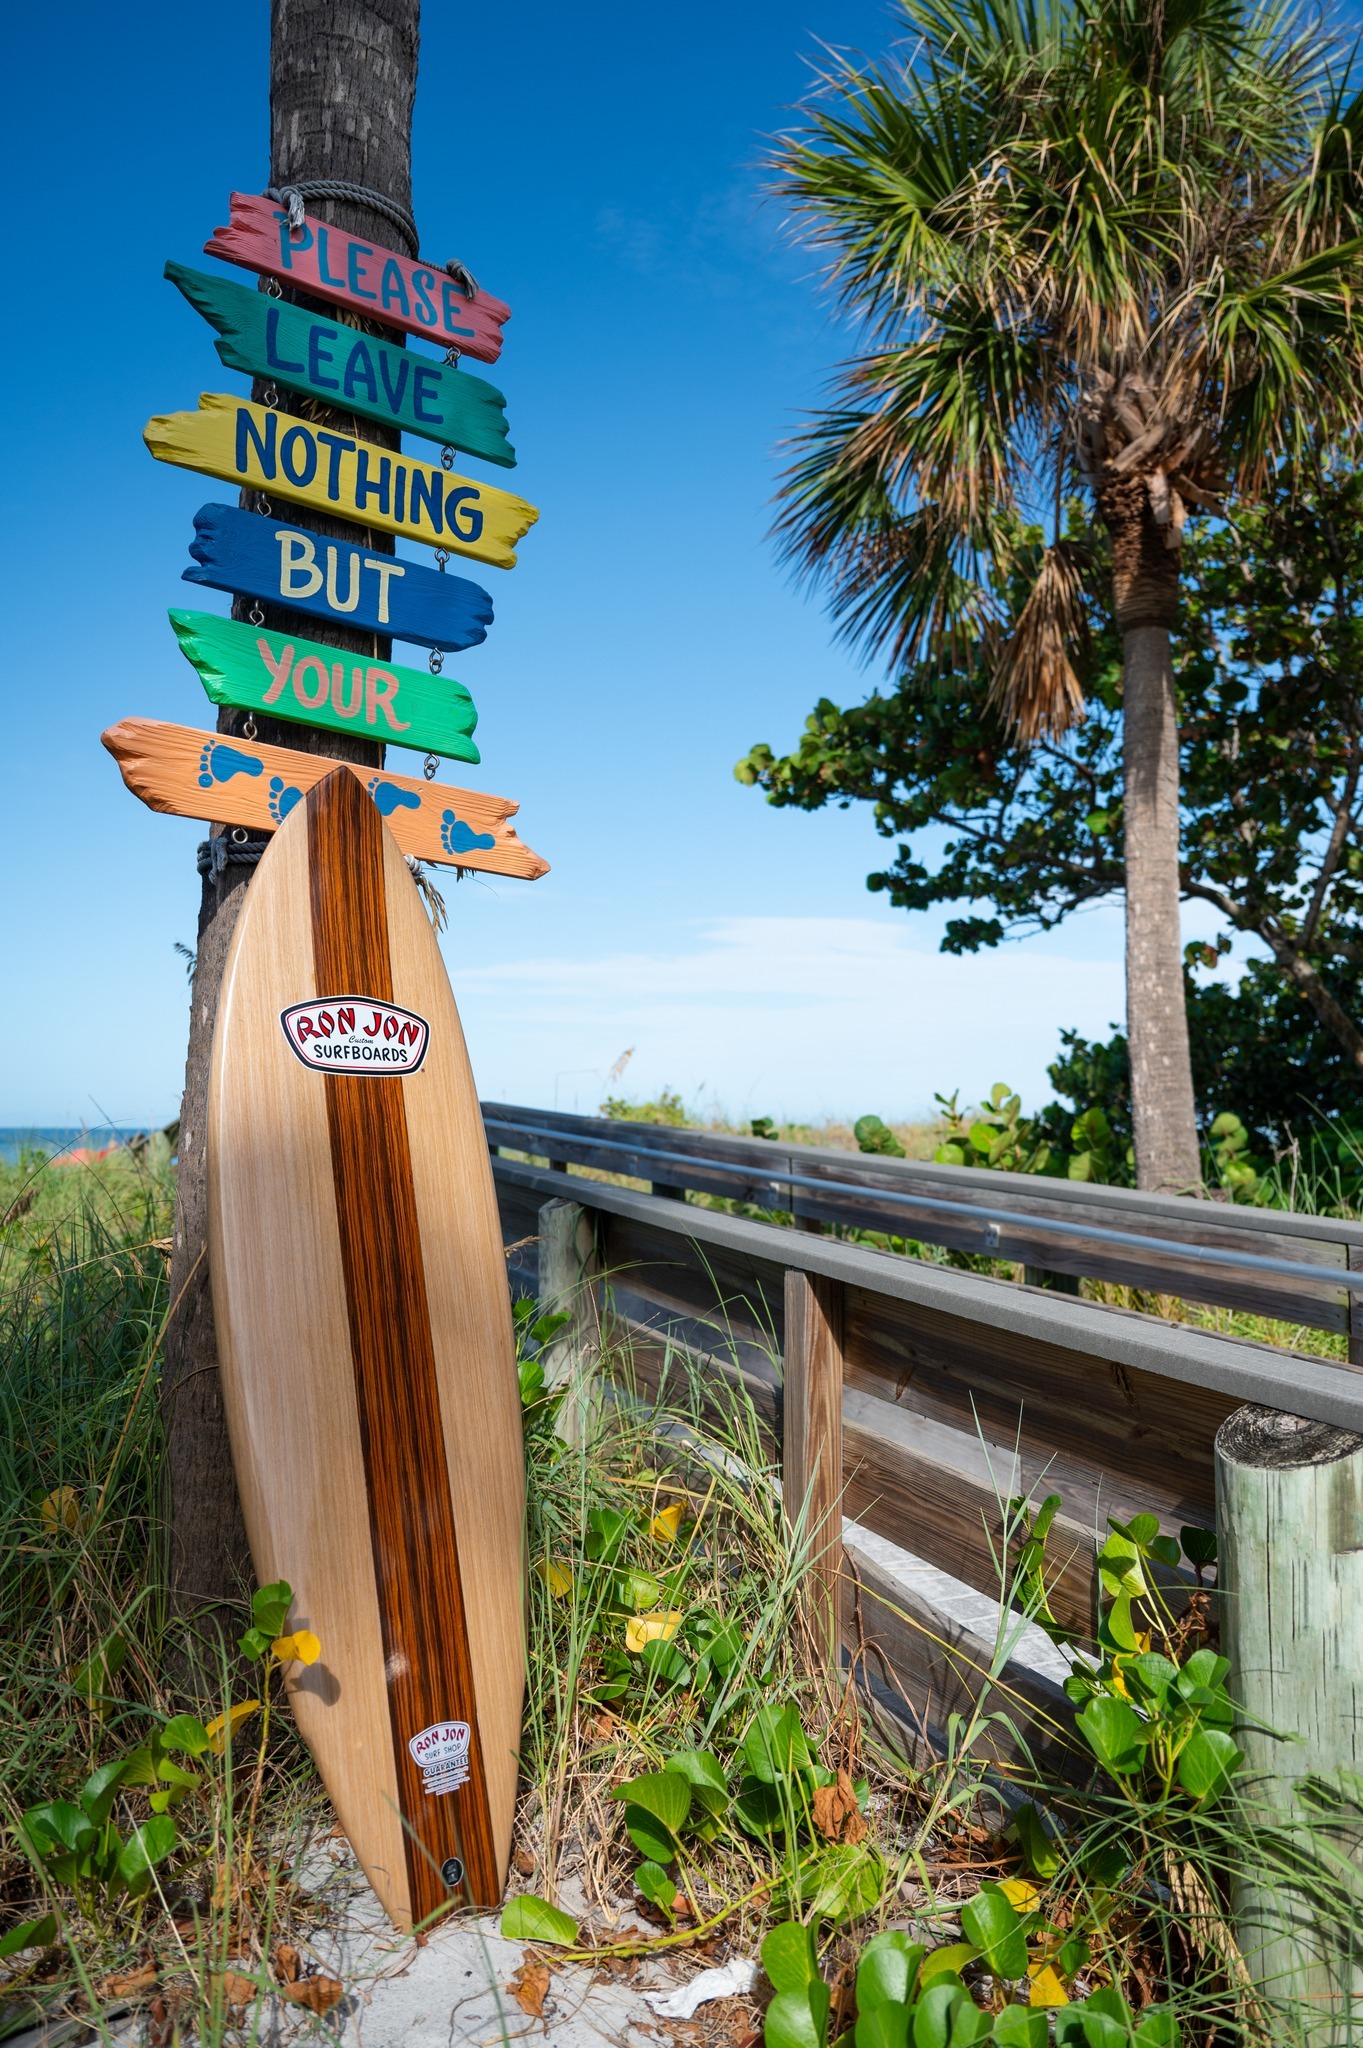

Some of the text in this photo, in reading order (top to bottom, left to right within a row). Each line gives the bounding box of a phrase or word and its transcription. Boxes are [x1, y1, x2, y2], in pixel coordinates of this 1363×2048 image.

[273, 211, 475, 338] PLEASE
[266, 308, 444, 425] LEAVE
[235, 407, 483, 542] NOTHING
[275, 531, 405, 623] BUT
[256, 638, 411, 731] YOUR
[297, 1008, 420, 1046] RON JON
[348, 1035, 374, 1044] Custom
[313, 1044, 408, 1063] SURFBOARDS
[416, 1728, 465, 1755] RON JON
[424, 1742, 462, 1761] SURF SHOP
[424, 1756, 468, 1776] GUARANTEE
